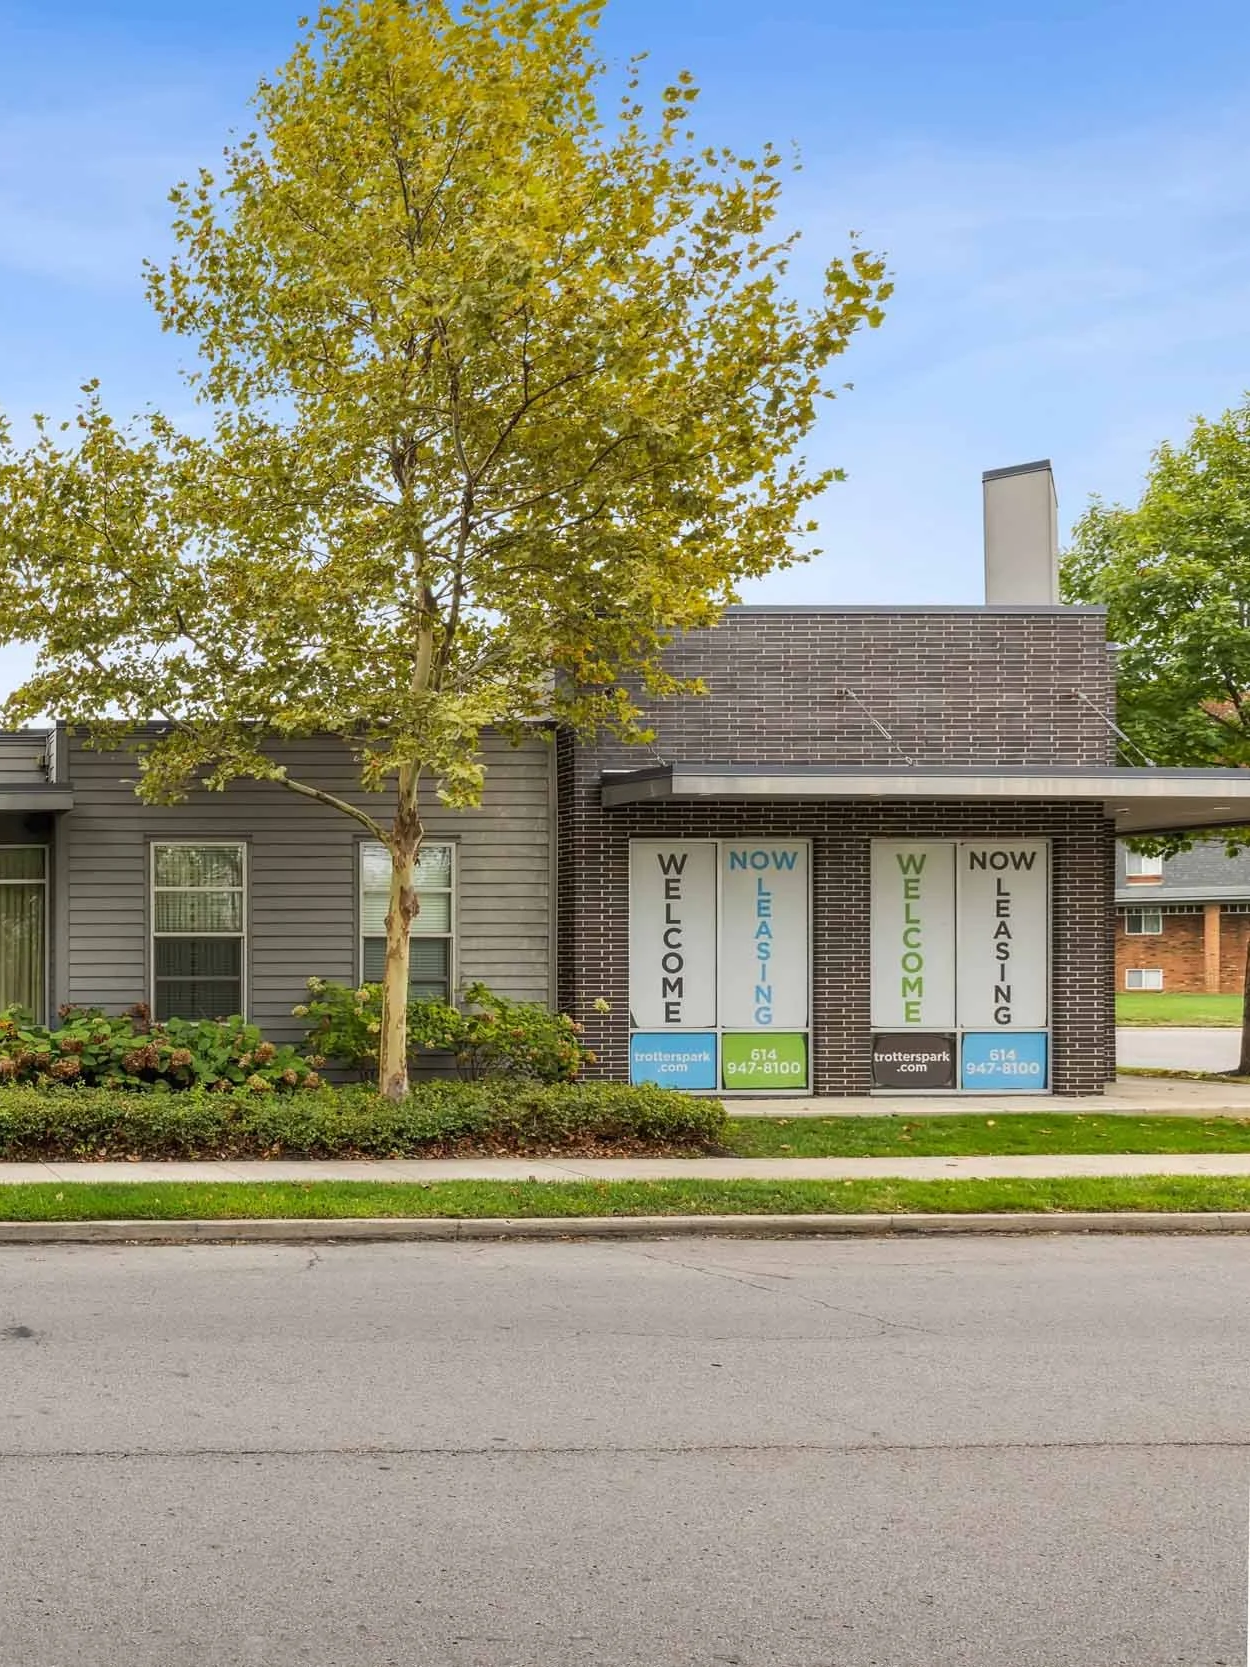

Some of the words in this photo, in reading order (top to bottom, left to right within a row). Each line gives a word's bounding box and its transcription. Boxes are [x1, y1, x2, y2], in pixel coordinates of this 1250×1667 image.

[729, 850, 798, 871] NOW
[969, 850, 1037, 871] NOW
[657, 853, 688, 1023] WELCOME
[896, 853, 927, 1023] WELCOME
[754, 878, 773, 1026] LEASING
[993, 878, 1012, 1026] LEASING
[634, 1050, 711, 1064] trotterspark
[750, 1049, 777, 1061] 614
[873, 1050, 951, 1064] trotterspark
[989, 1049, 1017, 1061] 614
[657, 1062, 688, 1073] .com
[727, 1062, 801, 1075] 947-8100
[896, 1062, 927, 1073] .com
[965, 1062, 1040, 1075] 947-8100
